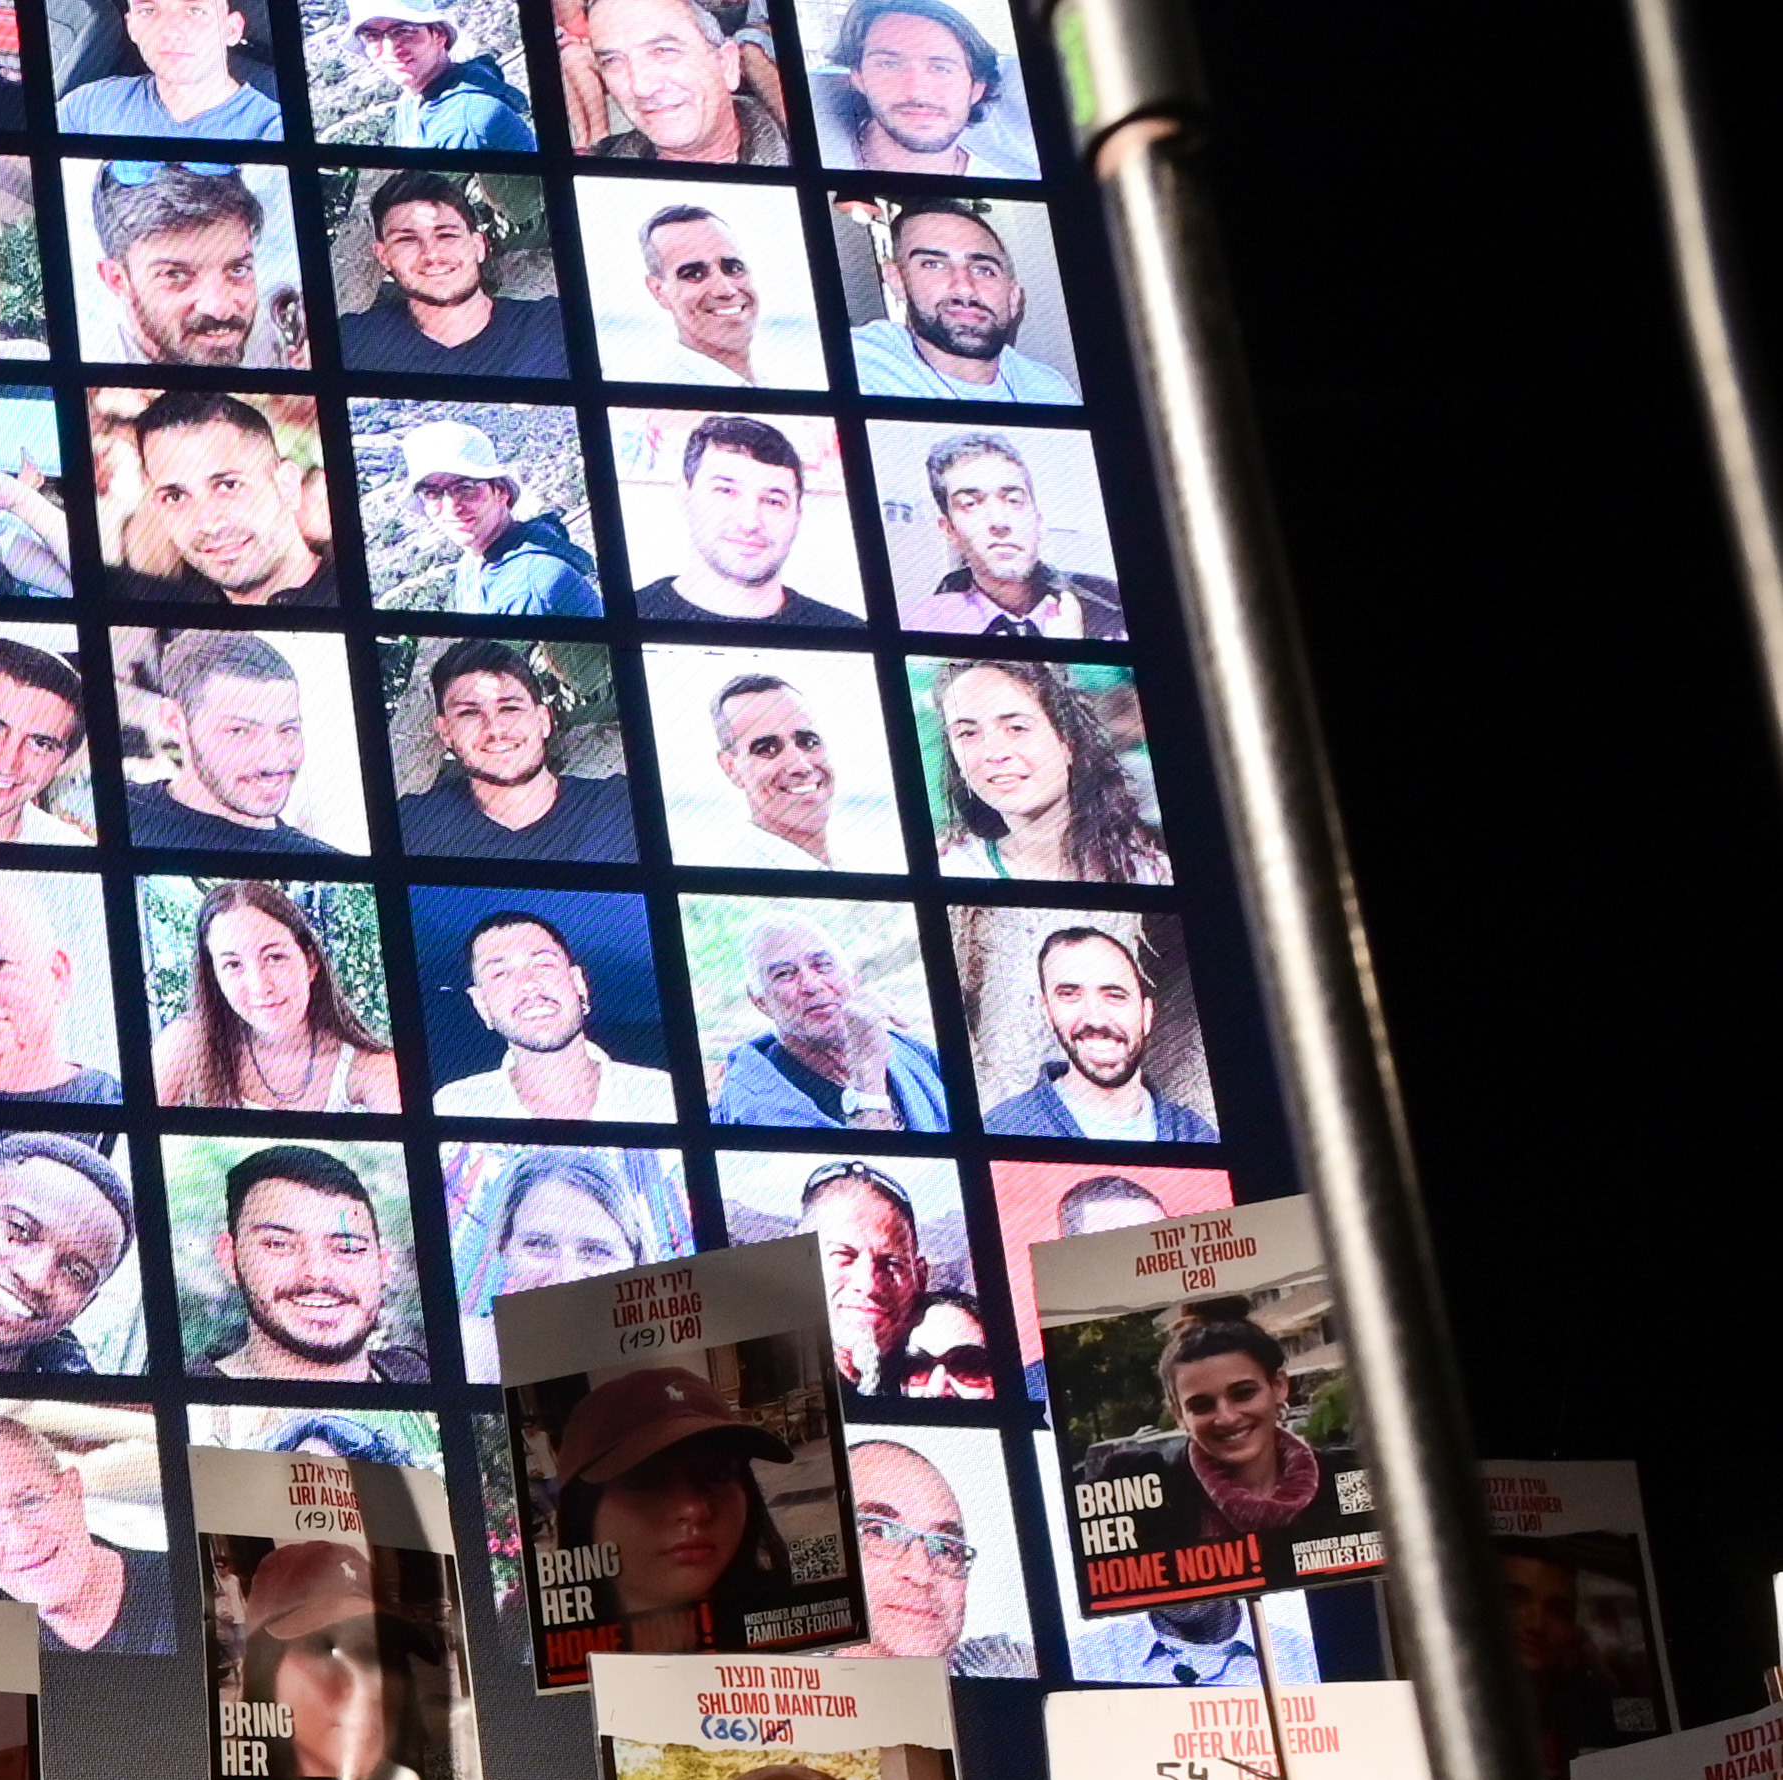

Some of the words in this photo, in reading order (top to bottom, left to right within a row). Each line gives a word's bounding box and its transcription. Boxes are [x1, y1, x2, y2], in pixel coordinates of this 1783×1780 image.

[1150, 1229, 1186, 1251] יהוד
[1190, 1218, 1233, 1243] ארבל
[1135, 1249, 1188, 1276] ARBEL
[1191, 1237, 1257, 1265] YEHOUD
[616, 1278, 655, 1304] אלבג
[662, 1268, 692, 1292] לירי
[1181, 1269, 1216, 1293] (28)
[612, 1304, 645, 1329] LIRI
[648, 1295, 702, 1321] ALBAG
[289, 1486, 317, 1506] LIRI
[320, 1488, 360, 1510] ALBAG
[1080, 1518, 1137, 1556] HER
[715, 1666, 766, 1689] מנצור
[771, 1667, 821, 1690] שלמה
[697, 1693, 771, 1715] SHLOMO
[775, 1695, 858, 1718] MANTZUR
[1190, 1698, 1259, 1729] קלדרון
[1173, 1732, 1223, 1759] OFER
[1231, 1727, 1340, 1756] KALERON
[221, 1739, 268, 1777] HER
